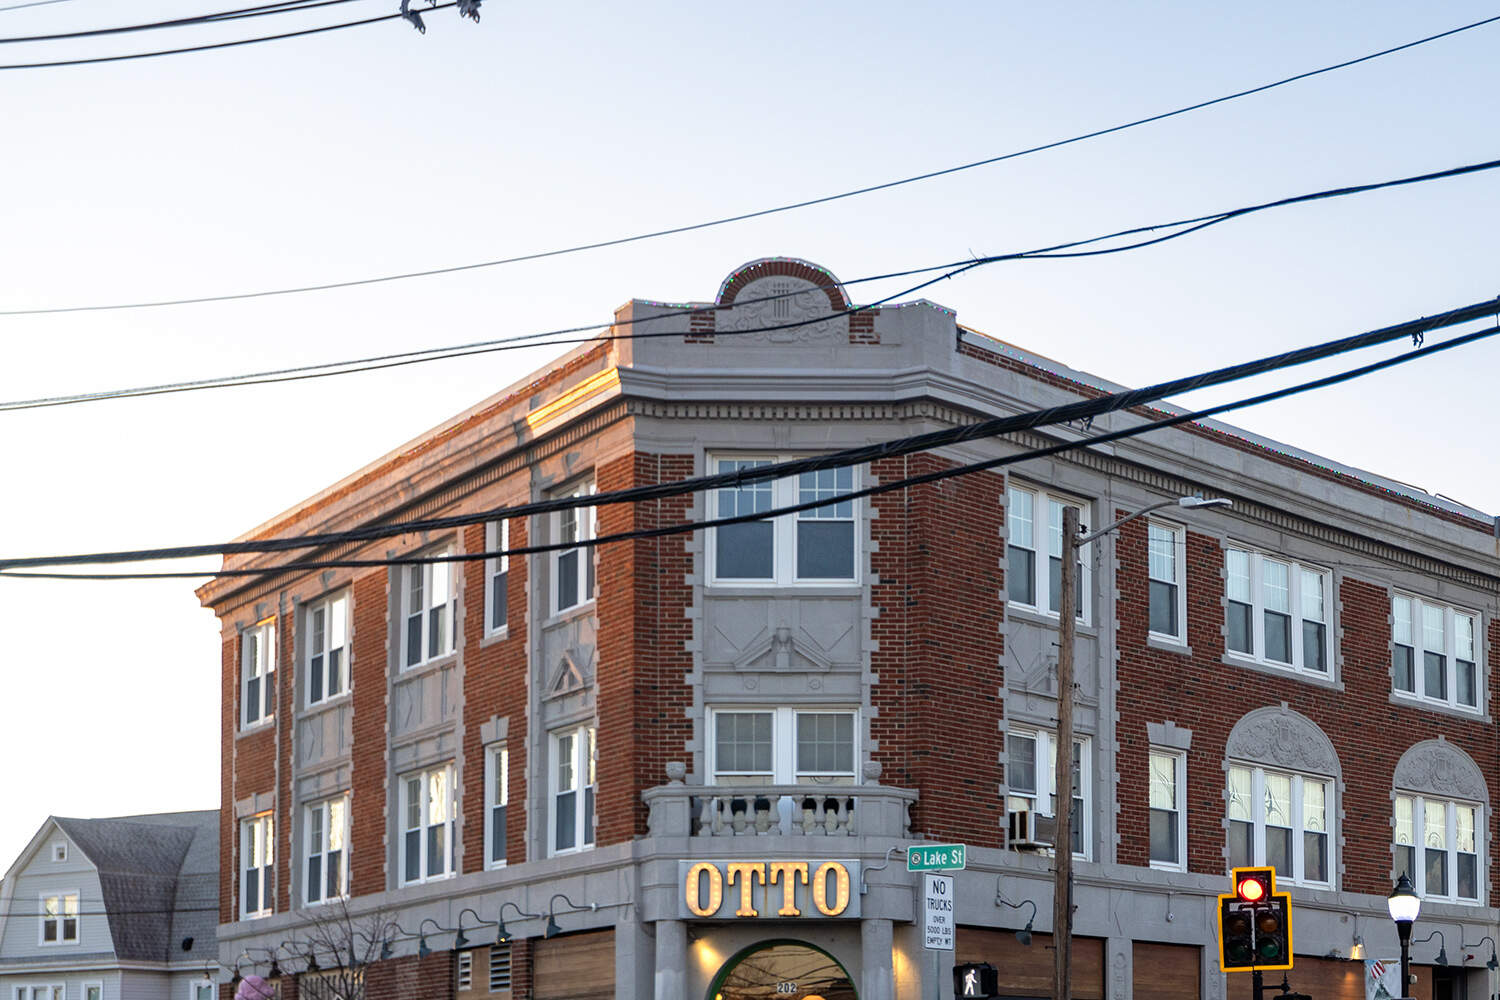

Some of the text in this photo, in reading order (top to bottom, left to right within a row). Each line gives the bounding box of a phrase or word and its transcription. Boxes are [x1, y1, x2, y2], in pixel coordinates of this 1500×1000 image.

[924, 849, 962, 866] Lake St
[685, 861, 850, 917] OTTO
[933, 880, 946, 895] NO
[927, 897, 952, 912] TRUCKS
[933, 915, 945, 924] OVER
[927, 925, 951, 935] 5000 LBS
[777, 982, 797, 993] 202
